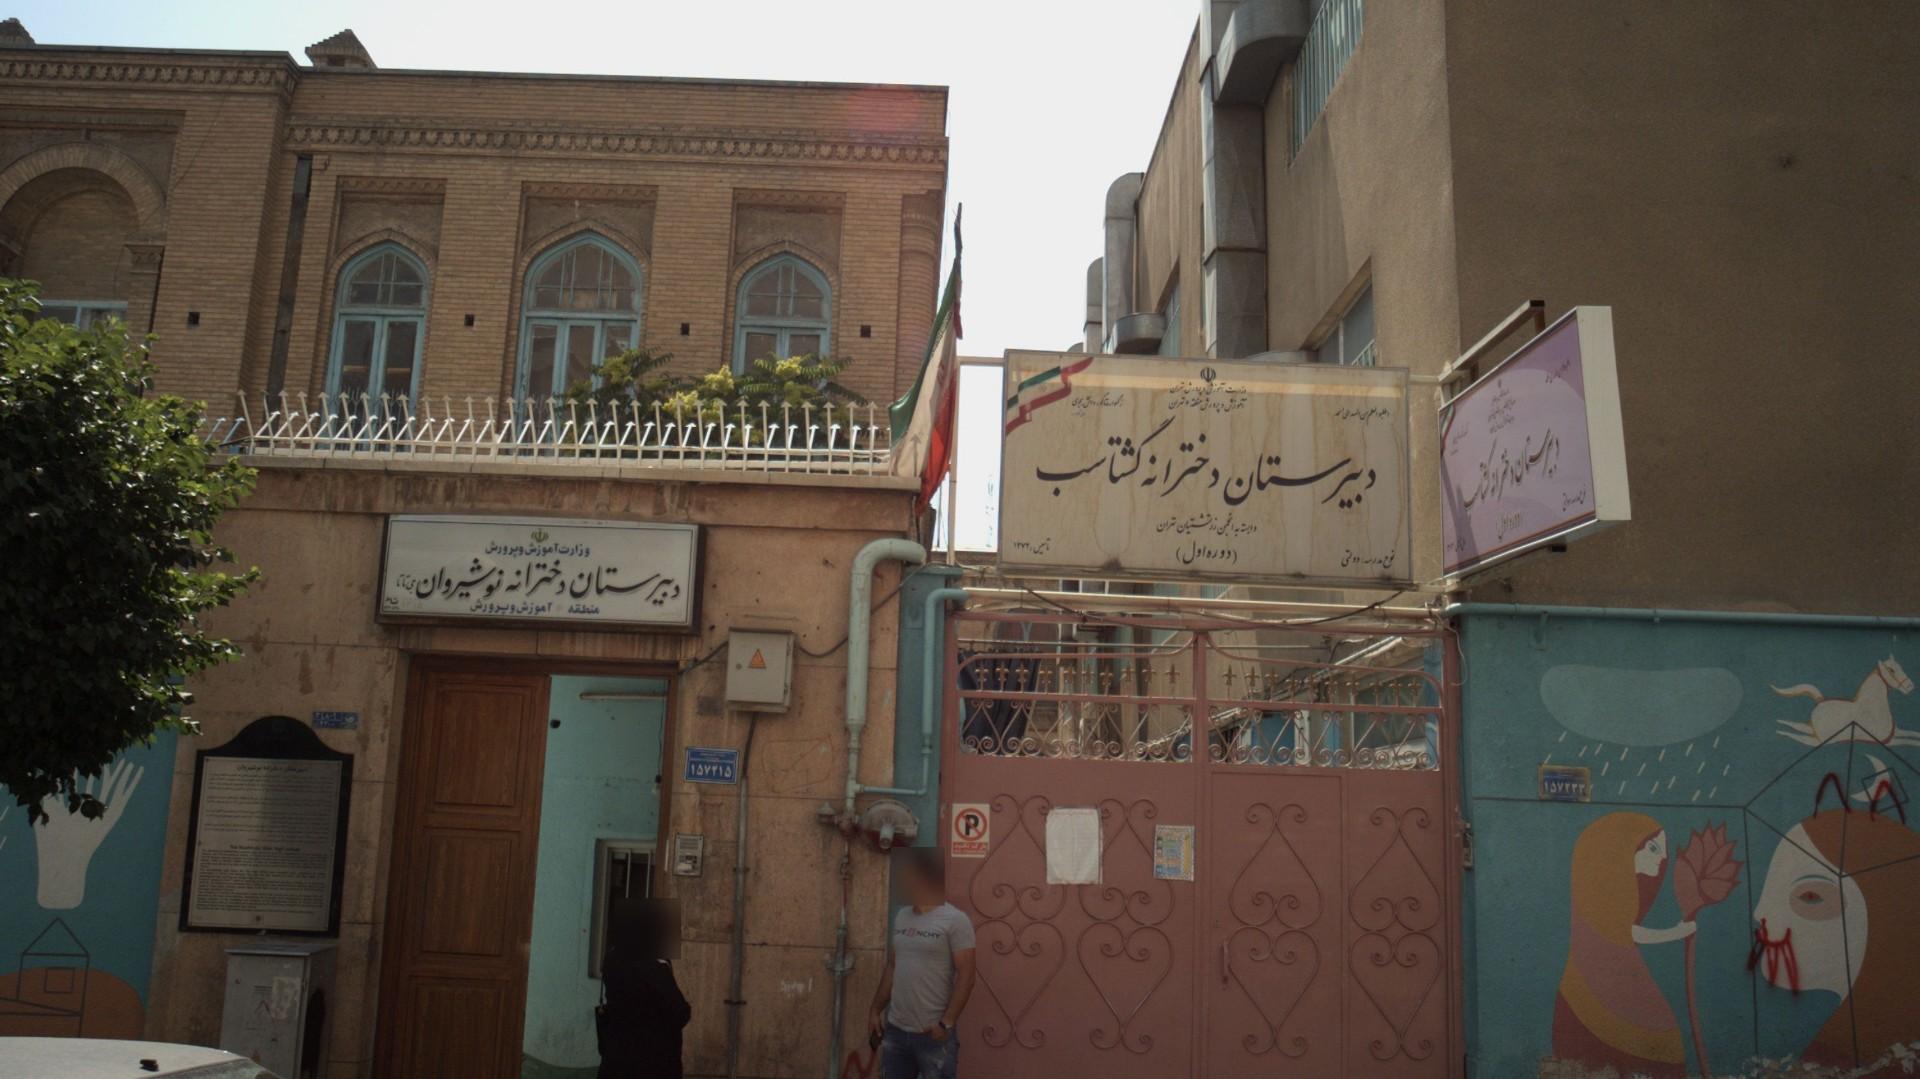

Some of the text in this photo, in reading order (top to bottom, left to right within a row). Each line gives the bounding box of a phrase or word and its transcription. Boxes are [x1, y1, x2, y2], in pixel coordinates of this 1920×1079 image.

[1036, 416, 1376, 508] دبیرستان دخترانه گشتاسب
[1156, 516, 1177, 533] تهران
[1176, 512, 1218, 535] زرتشتیان
[1216, 512, 1234, 537] انجمن
[1240, 521, 1257, 535] وابسته
[485, 540, 519, 558] پرورش
[525, 541, 559, 557] آموزش
[559, 543, 590, 557] وزارت
[416, 557, 505, 600] نوشیروان
[505, 559, 566, 596] دخترانه
[570, 565, 681, 605] دبیرستان
[470, 599, 511, 614] پرورش
[516, 601, 552, 615] آموزش
[568, 603, 600, 615] منطقه
[965, 814, 979, 836] P
